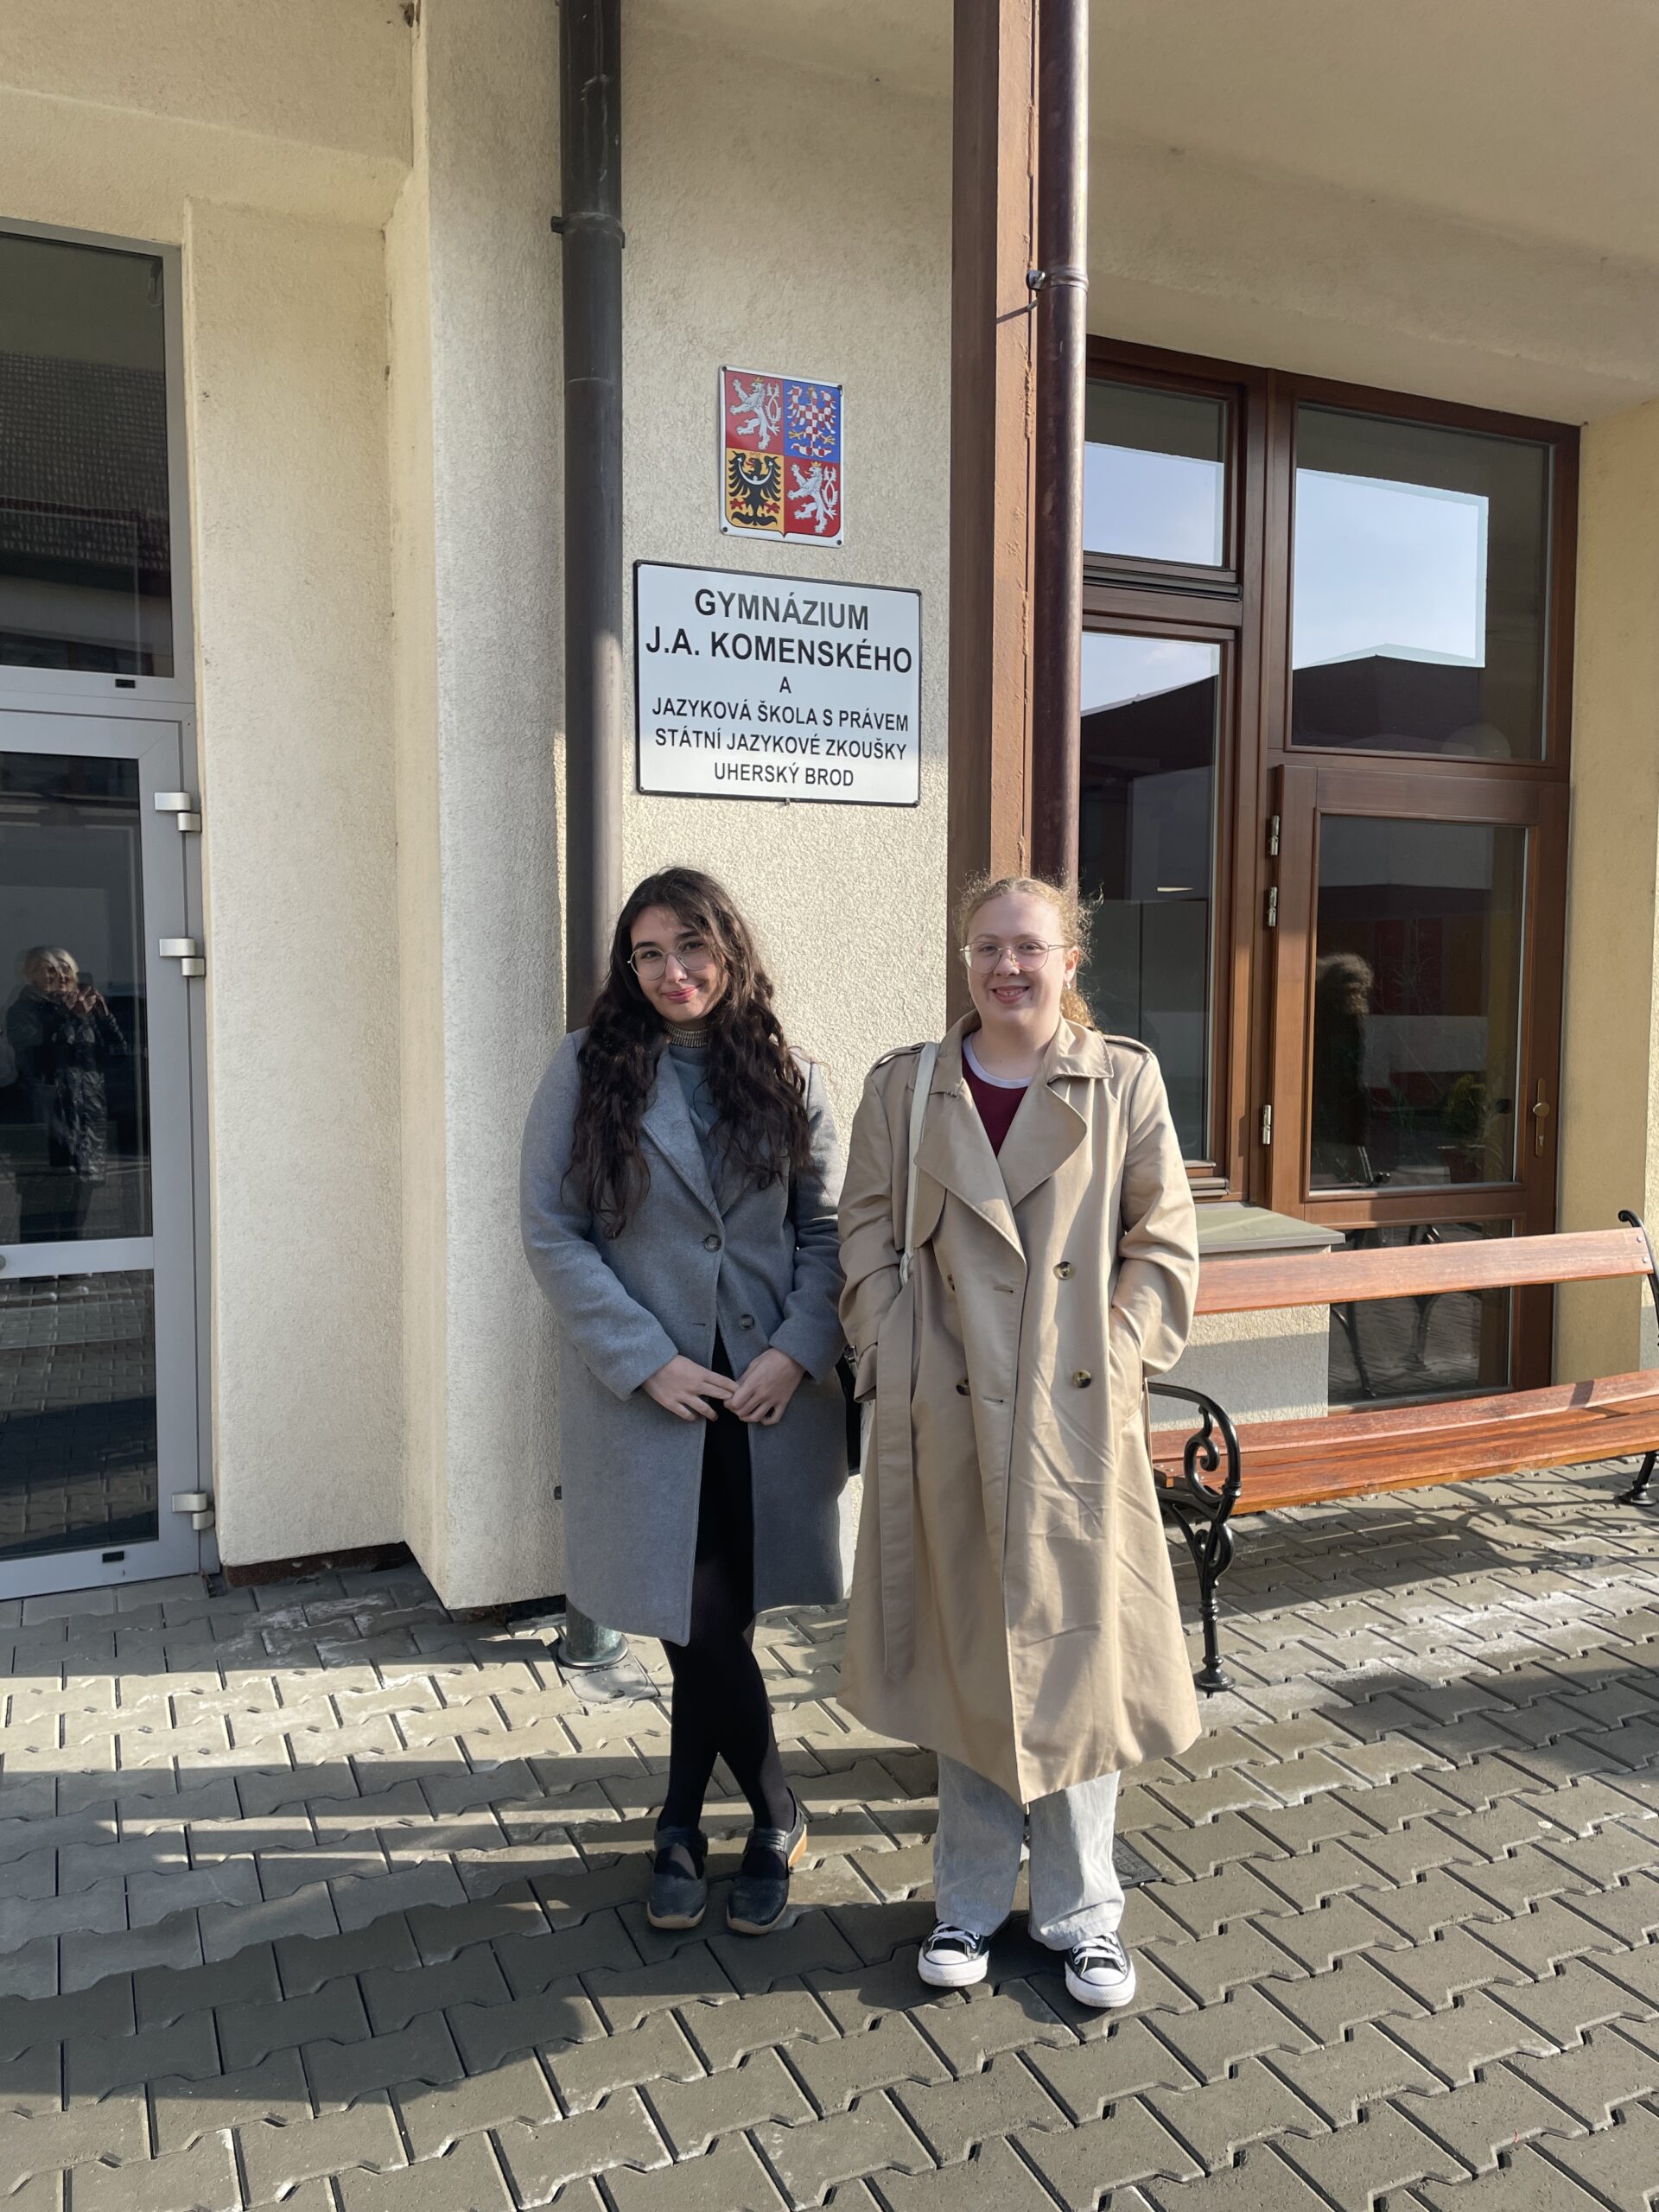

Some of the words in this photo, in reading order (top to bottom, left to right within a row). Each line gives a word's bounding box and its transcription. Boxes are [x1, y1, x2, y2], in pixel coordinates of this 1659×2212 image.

[695, 588, 869, 631] GYMNÁZIUM
[645, 626, 700, 656] J.A.
[711, 631, 912, 673] KOMENSKÉHO
[779, 677, 791, 694] A
[652, 697, 752, 721] JAZYKOVÁ
[757, 700, 817, 725] ŠKOLA
[823, 709, 832, 726] S
[839, 708, 908, 731] PRÁVEM
[655, 726, 721, 749] STÁTNÍ
[727, 733, 820, 755] JAZYKOVÉ
[825, 738, 907, 760] ZKOUŠKY
[715, 762, 799, 784] UHERSKÝ
[805, 767, 854, 786] BROD
